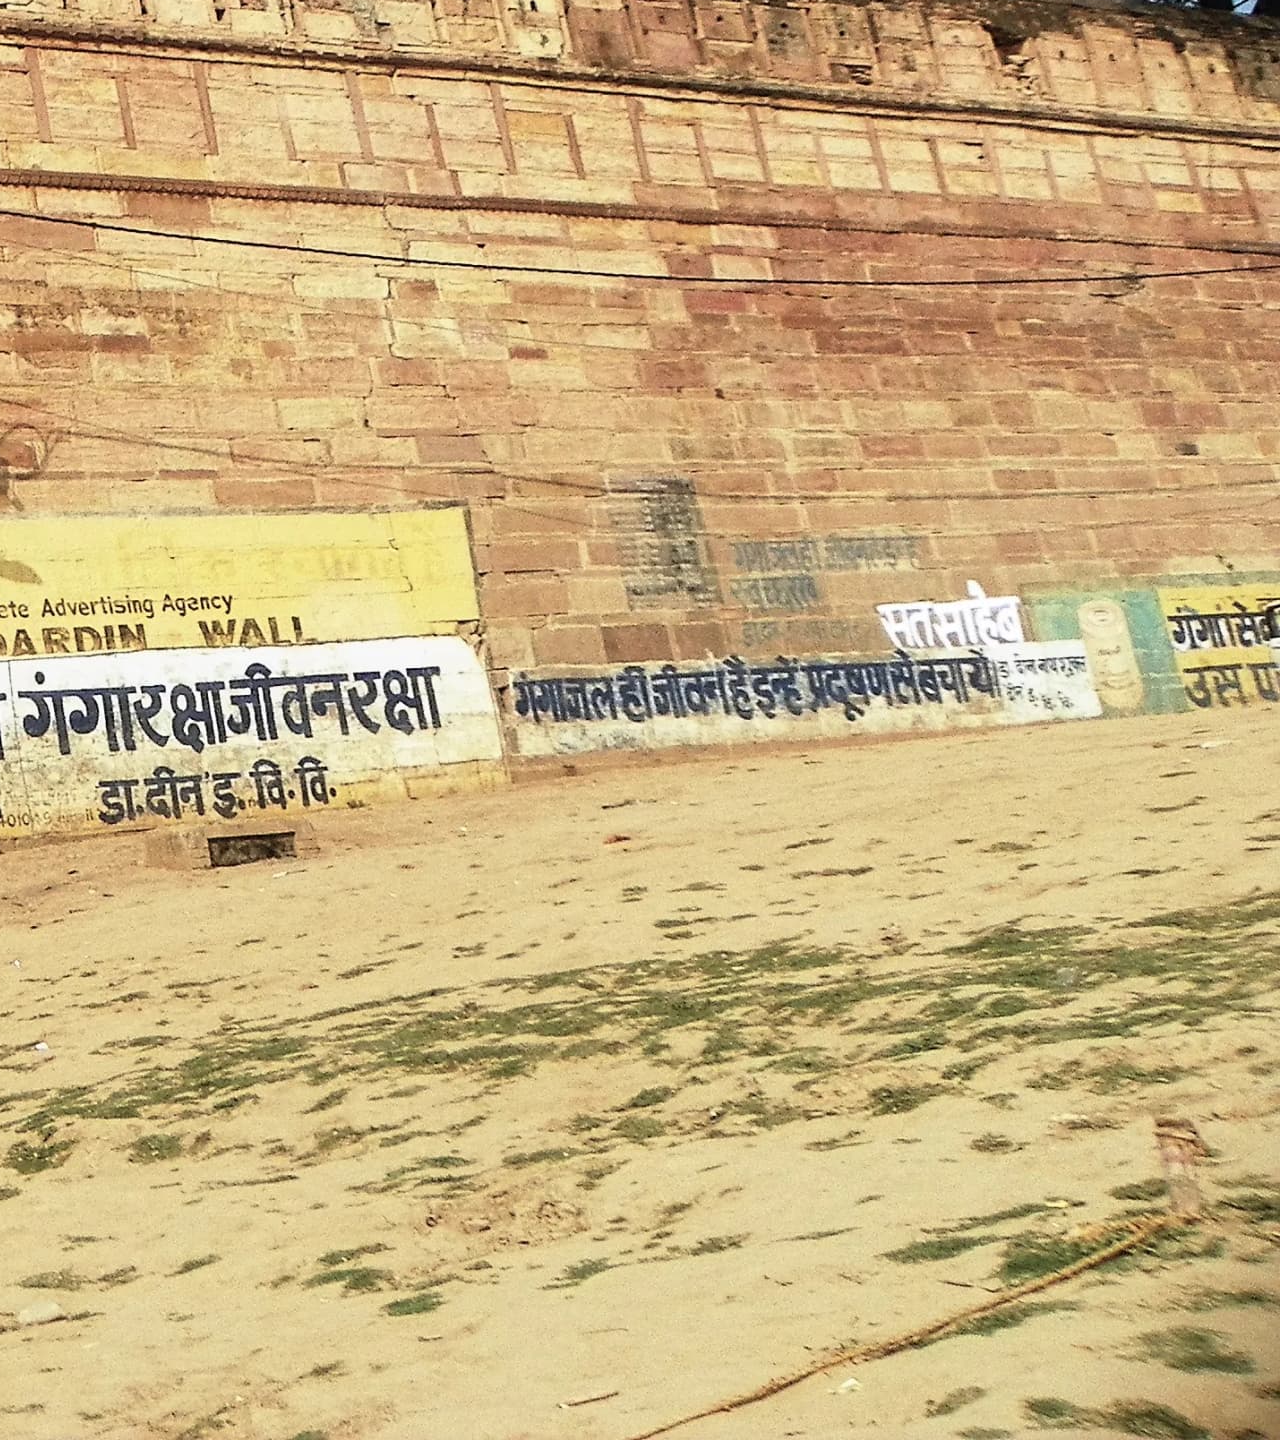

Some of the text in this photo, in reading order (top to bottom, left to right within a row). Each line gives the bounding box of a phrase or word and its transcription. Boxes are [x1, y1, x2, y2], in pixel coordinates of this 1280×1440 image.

[41, 594, 155, 619] Advertising
[162, 593, 233, 616] Agency
[198, 616, 318, 648] WALL
[18, 671, 138, 756] गंगा
[133, 680, 228, 753] रक्षा
[347, 665, 442, 735] रक्षा
